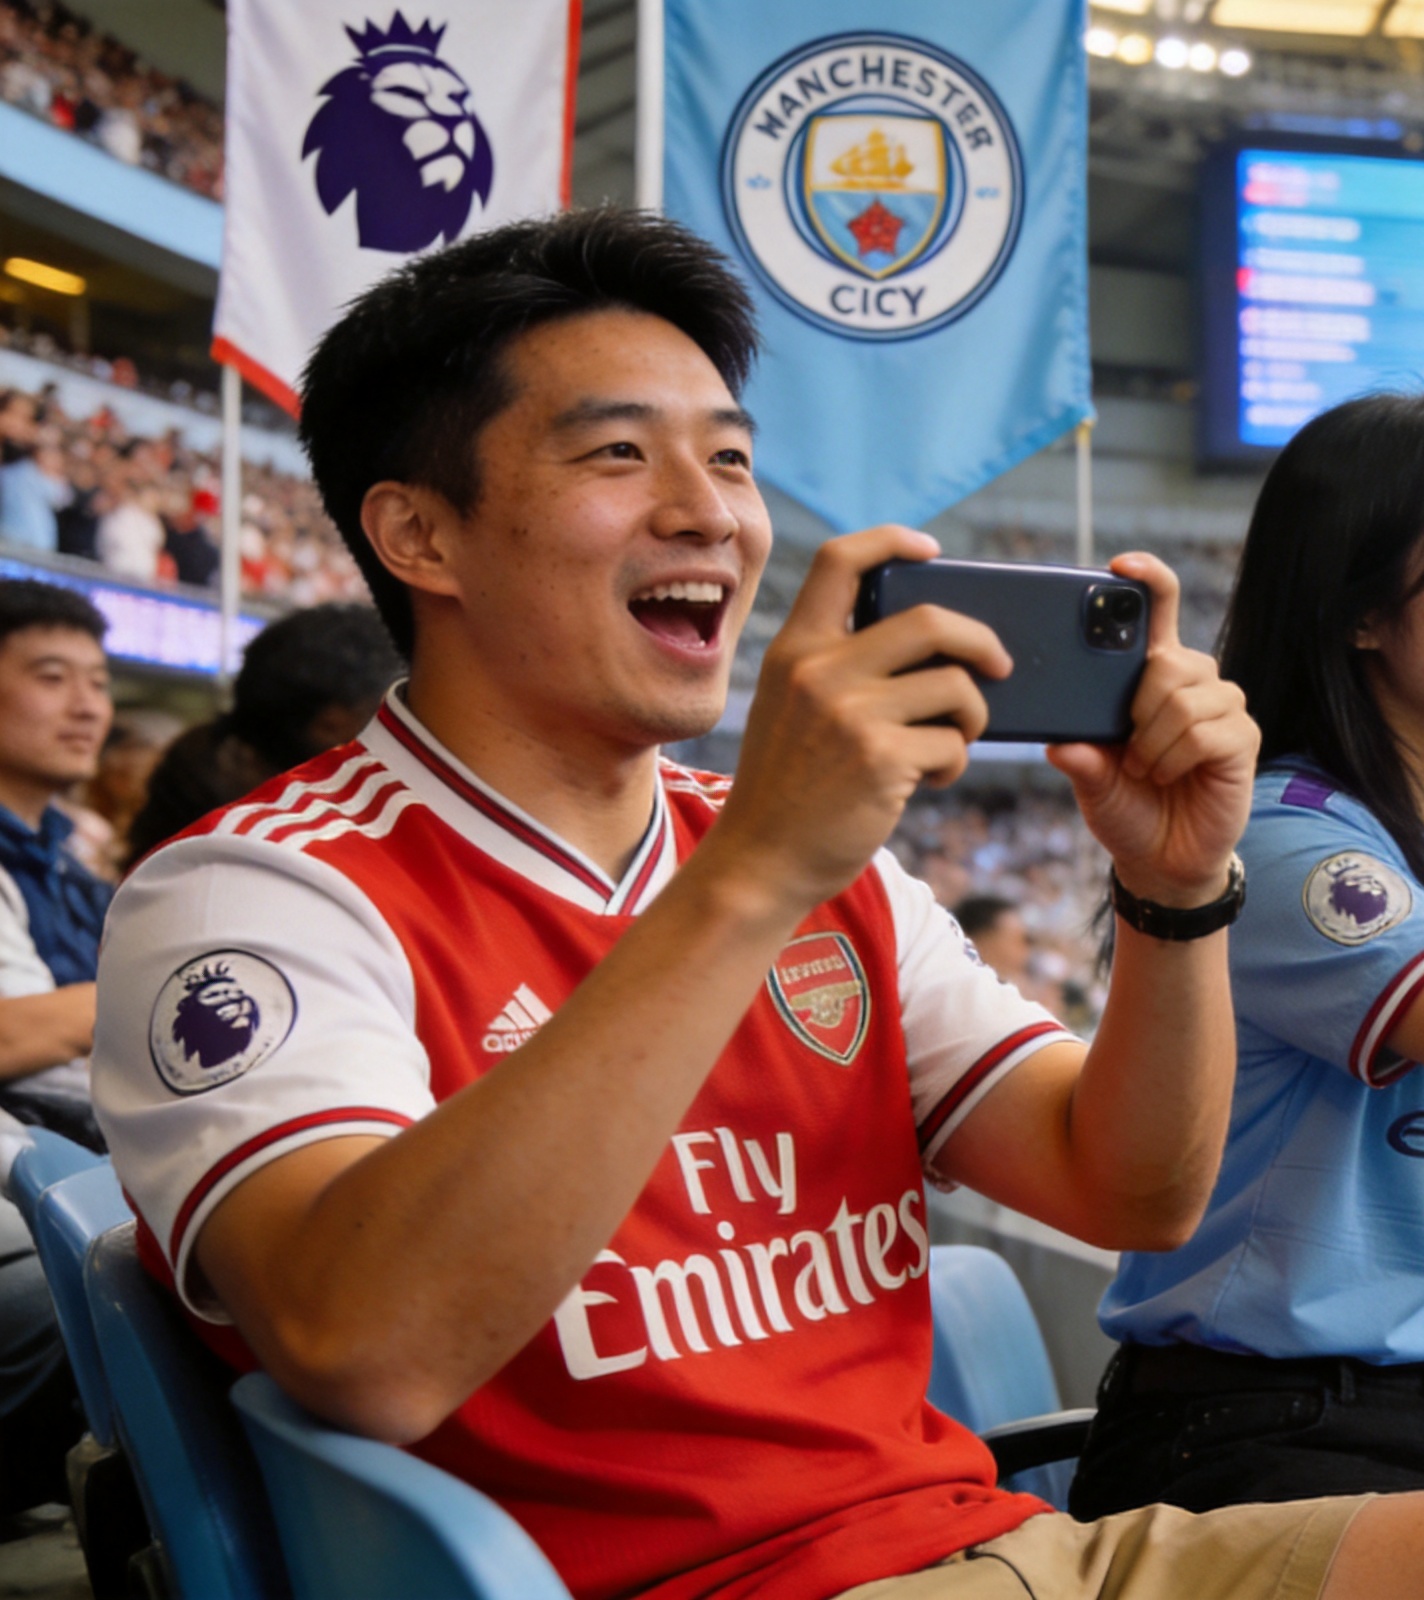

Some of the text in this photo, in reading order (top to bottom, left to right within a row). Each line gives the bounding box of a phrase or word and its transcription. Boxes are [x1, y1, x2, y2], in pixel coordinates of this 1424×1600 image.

[754, 54, 993, 151] MANCHESTER
[829, 284, 926, 318] CICY
[671, 1127, 797, 1214] Fly
[554, 1190, 929, 1381] Emirates
